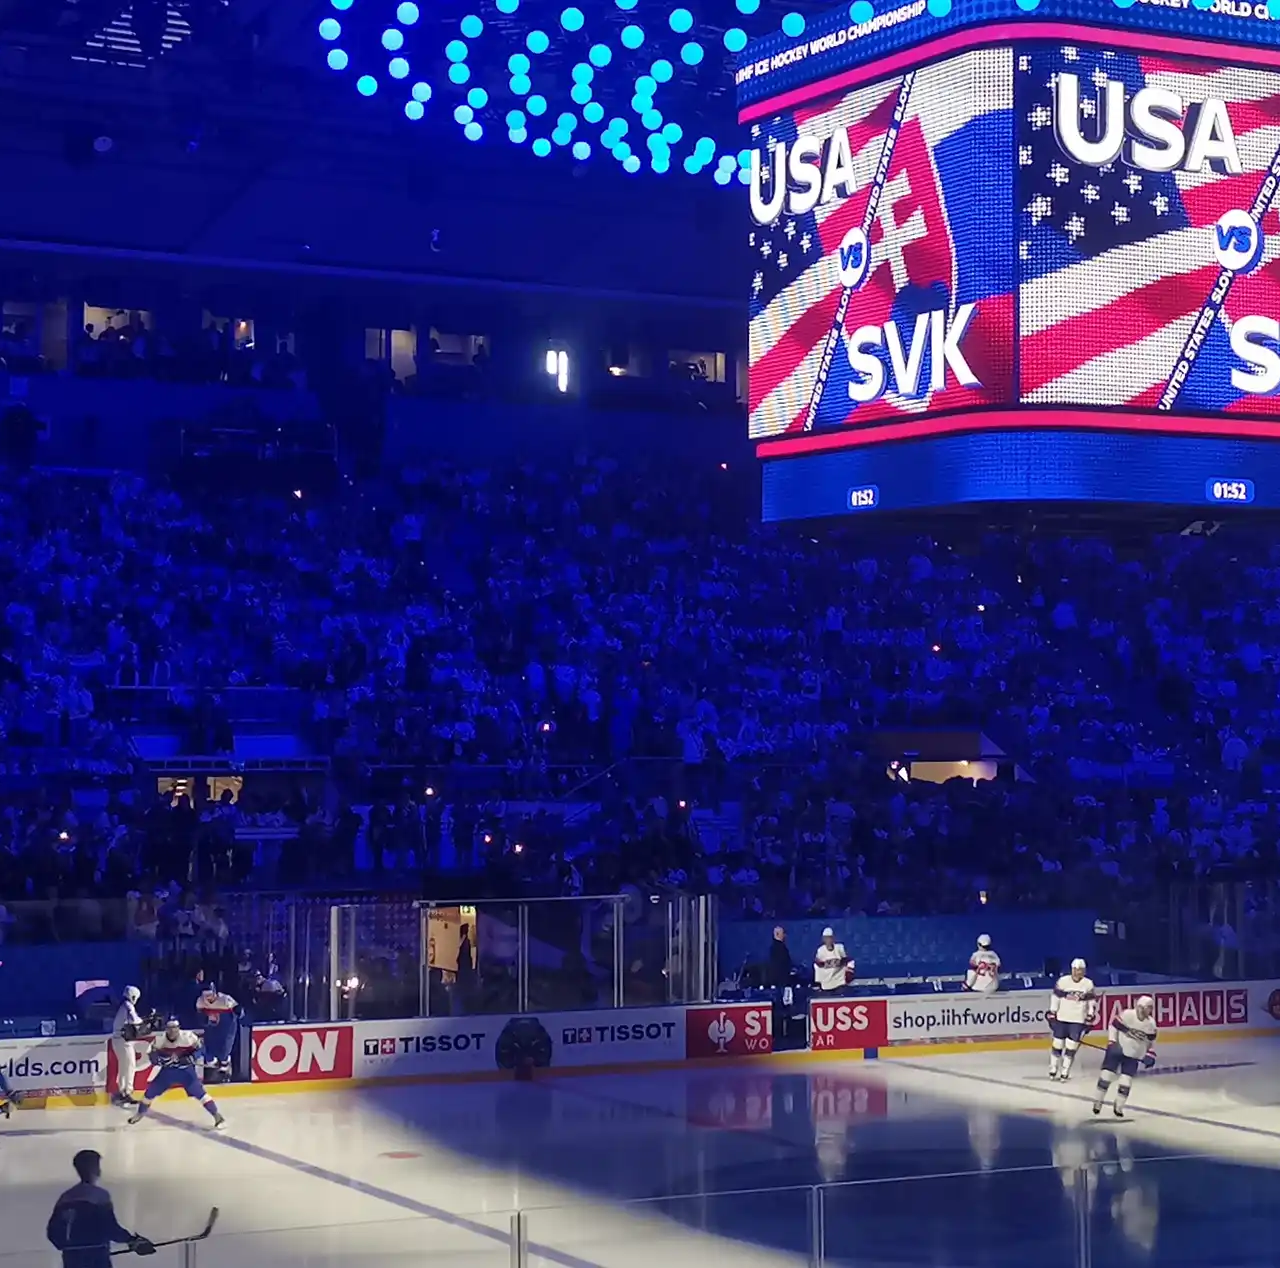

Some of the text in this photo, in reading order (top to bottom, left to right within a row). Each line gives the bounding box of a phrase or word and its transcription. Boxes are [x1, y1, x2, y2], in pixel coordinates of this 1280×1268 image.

[754, 58, 770, 76] ICE
[770, 43, 809, 71] HOCKEY
[809, 29, 847, 55] WORLD
[847, 0, 926, 40] CHAMPIONSHIP
[1053, 72, 1243, 175] USA
[749, 125, 858, 226] USA
[861, 184, 881, 236] NITED
[1249, 175, 1277, 222] NITED
[1216, 223, 1253, 252] VS
[839, 242, 863, 271] VS
[848, 301, 985, 402] SVK
[1159, 361, 1189, 411] UNITED
[1185, 306, 1215, 360] STATES
[804, 381, 823, 431] UNITED
[820, 327, 839, 382] STATES
[851, 489, 874, 506] 01:52
[1213, 482, 1246, 500] 01:52
[744, 1004, 869, 1037] STUSS
[893, 1005, 1051, 1031] shop.iihfworlds.c
[1088, 995, 1246, 1027] AHAUS
[399, 1034, 486, 1054] TISSOT
[595, 1022, 676, 1042] TISSOT
